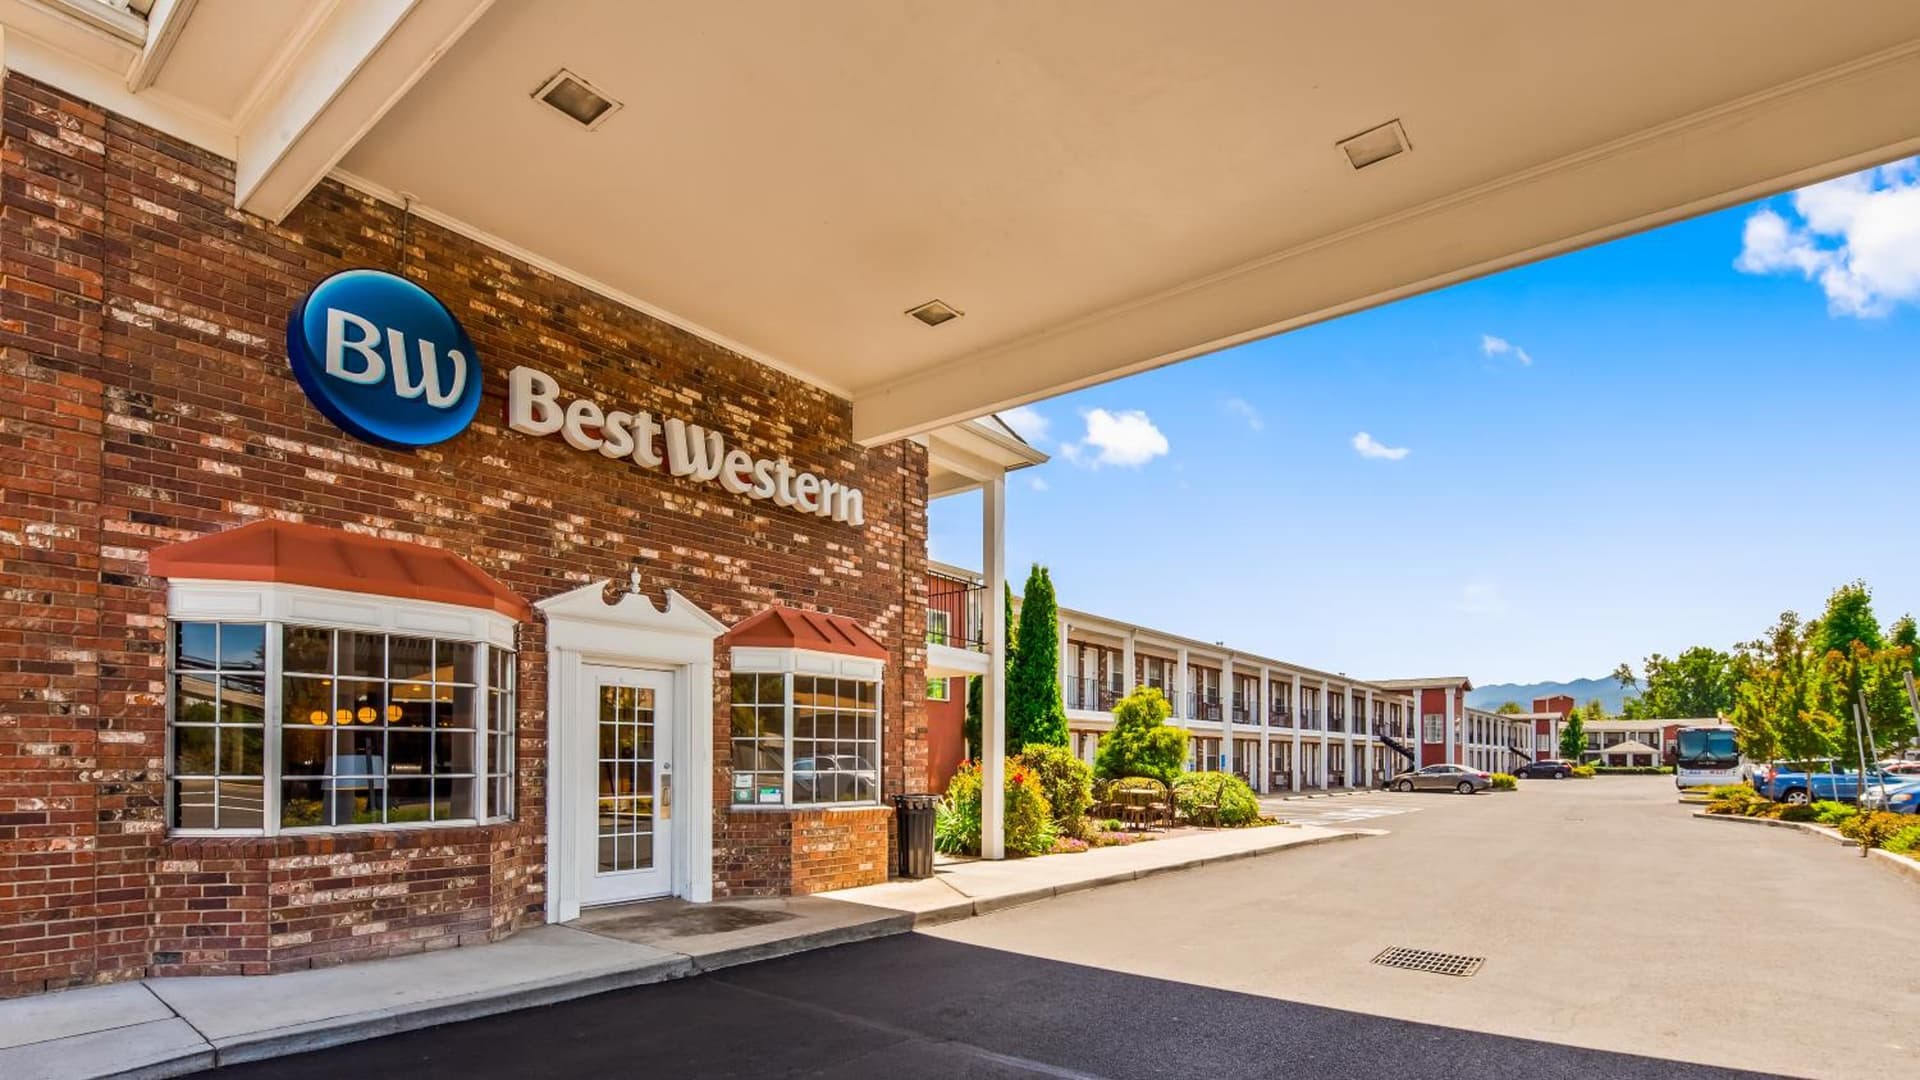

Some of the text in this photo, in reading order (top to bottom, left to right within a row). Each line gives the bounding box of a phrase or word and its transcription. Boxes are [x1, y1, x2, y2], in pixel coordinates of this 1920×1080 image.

[326, 308, 467, 409] BW
[509, 365, 864, 526] Best Western
